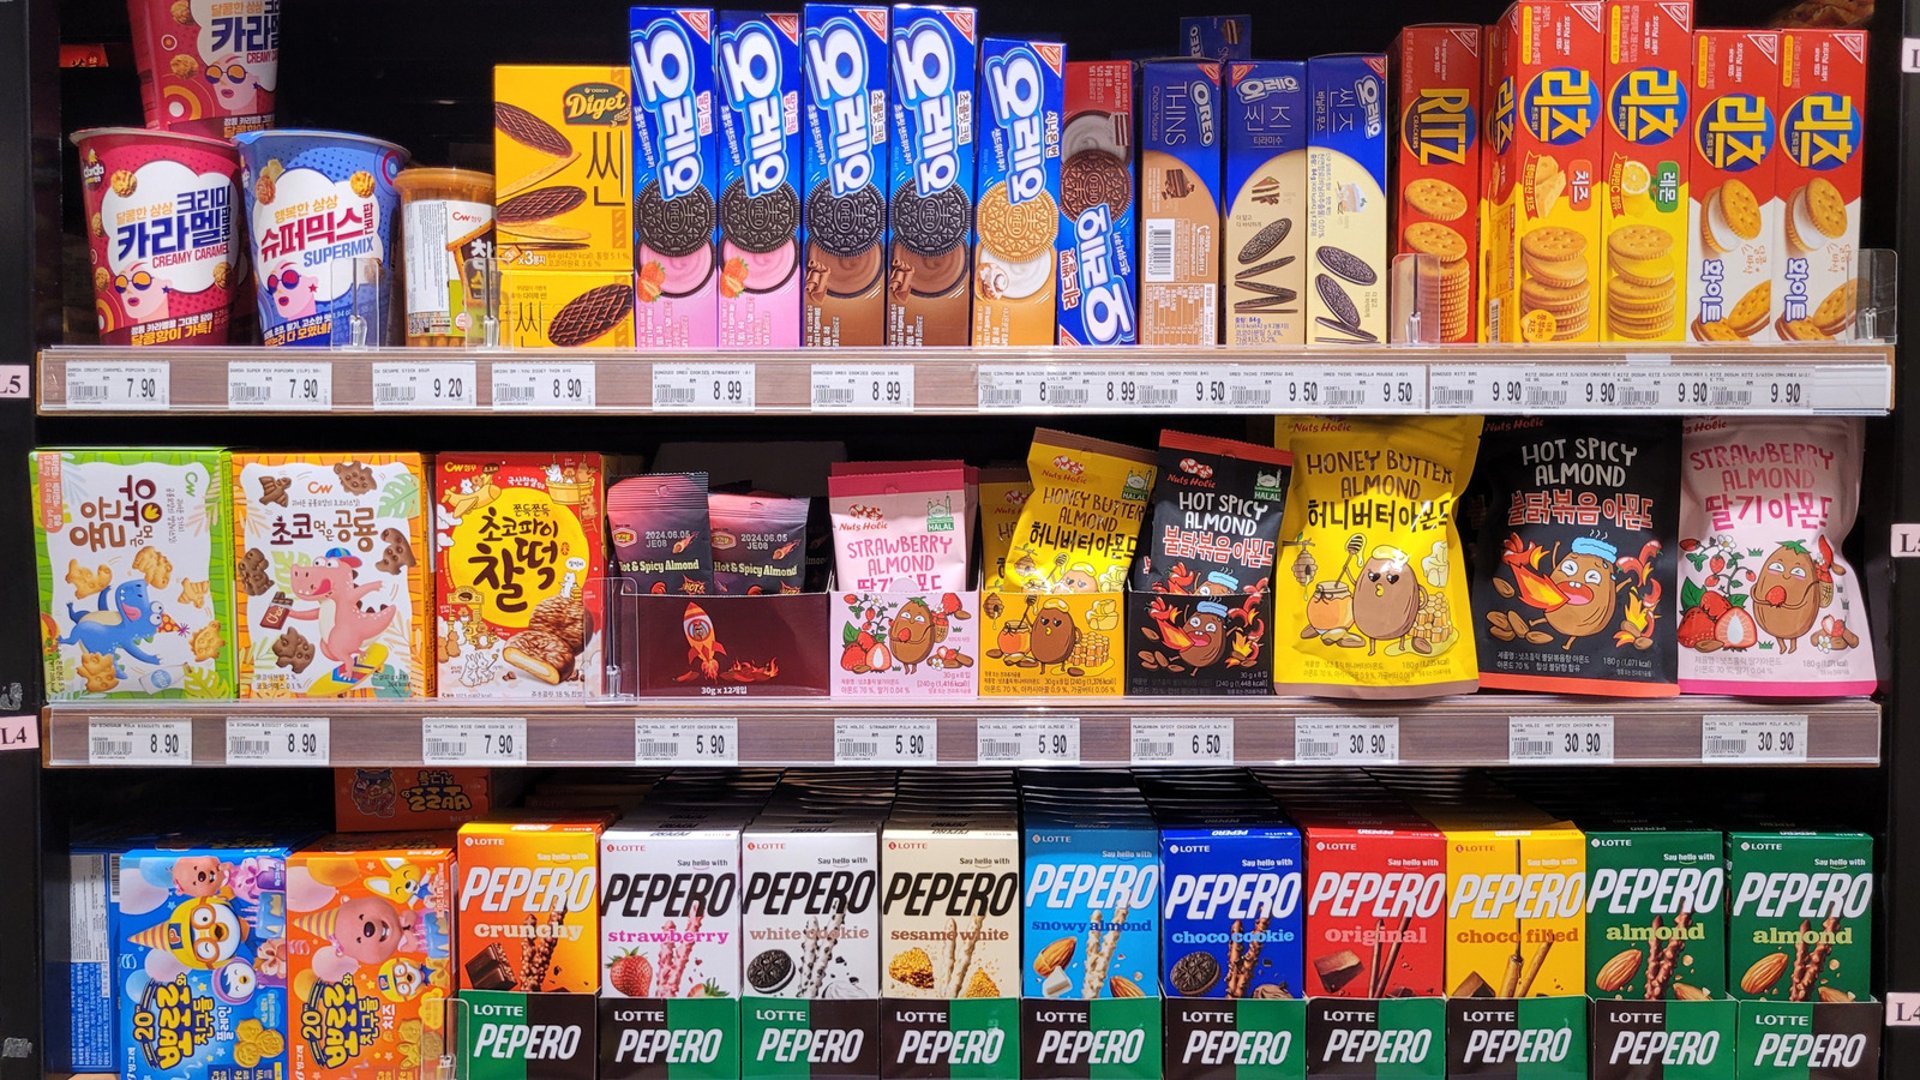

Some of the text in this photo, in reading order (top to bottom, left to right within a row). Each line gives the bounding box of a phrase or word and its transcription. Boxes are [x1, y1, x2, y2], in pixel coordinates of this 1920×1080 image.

[1239, 76, 1300, 102] 오레오
[566, 91, 626, 120] Diget
[634, 32, 701, 198] 오레오
[720, 34, 786, 197] 오레오
[804, 32, 873, 196] 오레오
[893, 33, 960, 196] 오레오
[1150, 85, 1160, 142] Choco Mousse
[1164, 81, 1188, 146] THINS
[1192, 81, 1213, 147] OREO
[1356, 75, 1382, 140] 오레오
[1532, 70, 1592, 142] 리츠
[1622, 70, 1678, 142] 리츠
[992, 57, 1043, 206] 오레오
[1046, 111, 1059, 145] 시나몬
[1418, 88, 1470, 166] RITZ
[1708, 96, 1767, 168] 리츠
[1794, 95, 1853, 168] 리츠
[1572, 170, 1590, 204] 치즈
[1659, 172, 1676, 202] 레몬
[117, 210, 222, 262] 카라멜
[261, 206, 364, 263] 슈퍼믹스
[152, 244, 229, 269] CREAMY CARAMEL
[303, 236, 374, 268] SUPERMIX
[1060, 249, 1079, 309] 레드벨벳
[1074, 205, 1132, 344] 오레오
[1700, 259, 1724, 324] 화이트
[127, 378, 156, 398] 7.90
[289, 378, 318, 398] 7.90
[434, 378, 462, 398] 9.20
[553, 378, 582, 398] 8.90
[712, 380, 742, 400] 8.99
[872, 380, 900, 401] 8.99
[1106, 381, 1136, 401] 8.99
[1196, 381, 1225, 401] 9.50
[1288, 381, 1318, 401] 9.50
[1382, 382, 1412, 402] 9.50
[1492, 381, 1522, 401] 9.90
[1585, 382, 1615, 402] 9.90
[1678, 382, 1708, 402] 9.90
[1770, 383, 1800, 402] 9.90
[1521, 436, 1638, 466] HOT SPICY
[1688, 443, 1836, 472] STRAWBERRY
[1306, 450, 1455, 484] HONEY BUTTER
[1534, 462, 1627, 488] ALMOND
[1722, 466, 1816, 492] ALMOND
[1340, 474, 1422, 500] ALMOND
[118, 474, 164, 548] 우유 먹은
[1043, 486, 1148, 522] HONEY BUTTER
[1178, 491, 1270, 522] HOT SPICY
[1307, 498, 1452, 532] 허니버터아몬드
[1506, 490, 1654, 531] 불닭볶음아몬드
[1705, 493, 1834, 530] 딸기아몬드
[70, 496, 126, 552] 공룡
[270, 507, 378, 552] 초코 먹은 공룡
[478, 506, 558, 542] 초코파이
[838, 520, 890, 532] Nuts Holic
[928, 523, 954, 531] HALAL
[1058, 506, 1118, 534] ALMOND
[1184, 510, 1258, 537] ALMOND
[847, 536, 954, 560] STRAWBERRY
[1028, 520, 1140, 560] 허니버터아몬드
[1162, 524, 1273, 568] 불닭볶음아몬드
[468, 537, 558, 612] 찰떡
[632, 562, 638, 571] &
[639, 560, 664, 574] Spicy
[665, 559, 700, 571] Almond
[714, 563, 798, 577] Hot & Spicy Almond
[868, 554, 936, 576] ALMOND
[2, 726, 27, 746] L4
[150, 734, 179, 754] 8.90
[288, 733, 316, 753] 8.90
[484, 734, 513, 754] 7.90
[696, 734, 725, 754] 5.90
[895, 734, 924, 754] 5.90
[1038, 734, 1068, 754] 5.90
[1192, 734, 1220, 754] 6.50
[1350, 734, 1386, 754] 30.90
[1564, 732, 1601, 753] 30.90
[1757, 732, 1794, 752] 30.90
[615, 844, 646, 852] LOTTE
[460, 866, 596, 912] PEPERO
[600, 872, 736, 918] PEPERO
[742, 870, 876, 916] PEPERO
[883, 872, 1018, 917] PEPERO
[1026, 864, 1158, 910] PEPERO
[1164, 872, 1302, 920] PEPERO
[1308, 871, 1446, 918] PEPERO
[1450, 872, 1586, 919] PEPERO
[1586, 867, 1724, 914] PEPERO
[1732, 872, 1873, 918] PEPERO
[474, 921, 584, 942] crunchy
[608, 928, 730, 946] strawberry
[749, 926, 801, 941] white
[890, 926, 1009, 941] sesame white
[1032, 918, 1152, 934] snowy almond
[1172, 929, 1296, 944] choco cookie
[1324, 926, 1428, 947] original
[1456, 927, 1579, 944] choco filled
[1606, 922, 1705, 941] almond
[1752, 928, 1853, 945] almond
[194, 996, 214, 1046] 친구들
[216, 1007, 233, 1042] 플레인
[473, 1004, 524, 1018] LOTTE
[614, 1010, 664, 1022] LOTTE
[756, 1010, 806, 1022] LOTTE
[896, 1010, 948, 1022] LOTTE
[1036, 1010, 1088, 1022] LOTTE
[1182, 1010, 1234, 1022] LOTTE
[1323, 1011, 1376, 1022] LOTTE
[1463, 1011, 1515, 1022] LOTTE
[1610, 1012, 1662, 1024] LOTTE
[1756, 1014, 1808, 1026] LOTTE
[473, 1024, 582, 1060] PEPERO
[615, 1028, 724, 1064] PEPERO
[756, 1028, 866, 1063] PEPERO
[896, 1028, 1005, 1064] PEPERO
[1036, 1028, 1145, 1064] PEPERO
[1181, 1029, 1292, 1065] PEPERO
[1322, 1028, 1432, 1063] PEPERO
[1463, 1028, 1573, 1064] PEPERO
[1610, 1031, 1720, 1065] PEPERO
[1754, 1034, 1866, 1068] PEPERO
